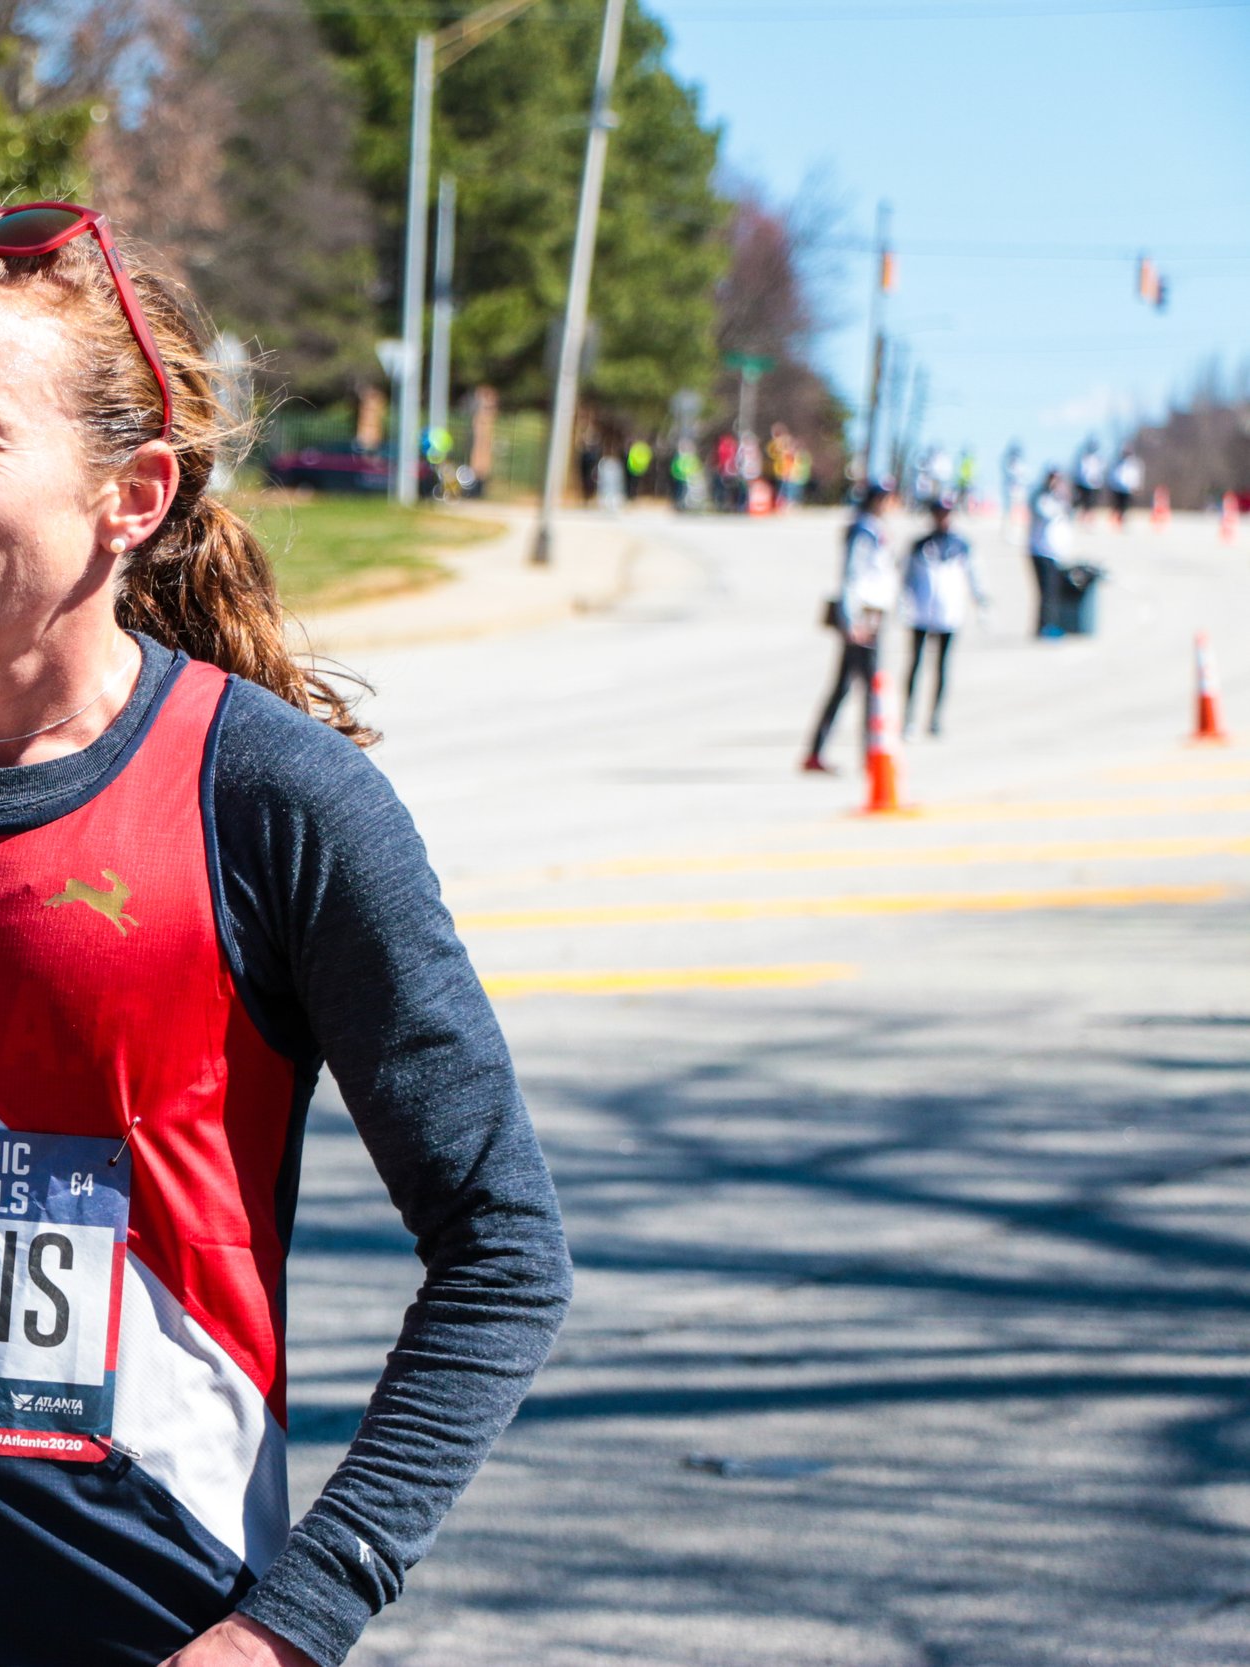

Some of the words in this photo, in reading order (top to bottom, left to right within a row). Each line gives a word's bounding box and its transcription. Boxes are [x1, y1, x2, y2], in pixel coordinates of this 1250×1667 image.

[69, 1172, 94, 1197] 64
[34, 1396, 83, 1409] ATLANTA
[63, 1408, 83, 1416] CLUB
